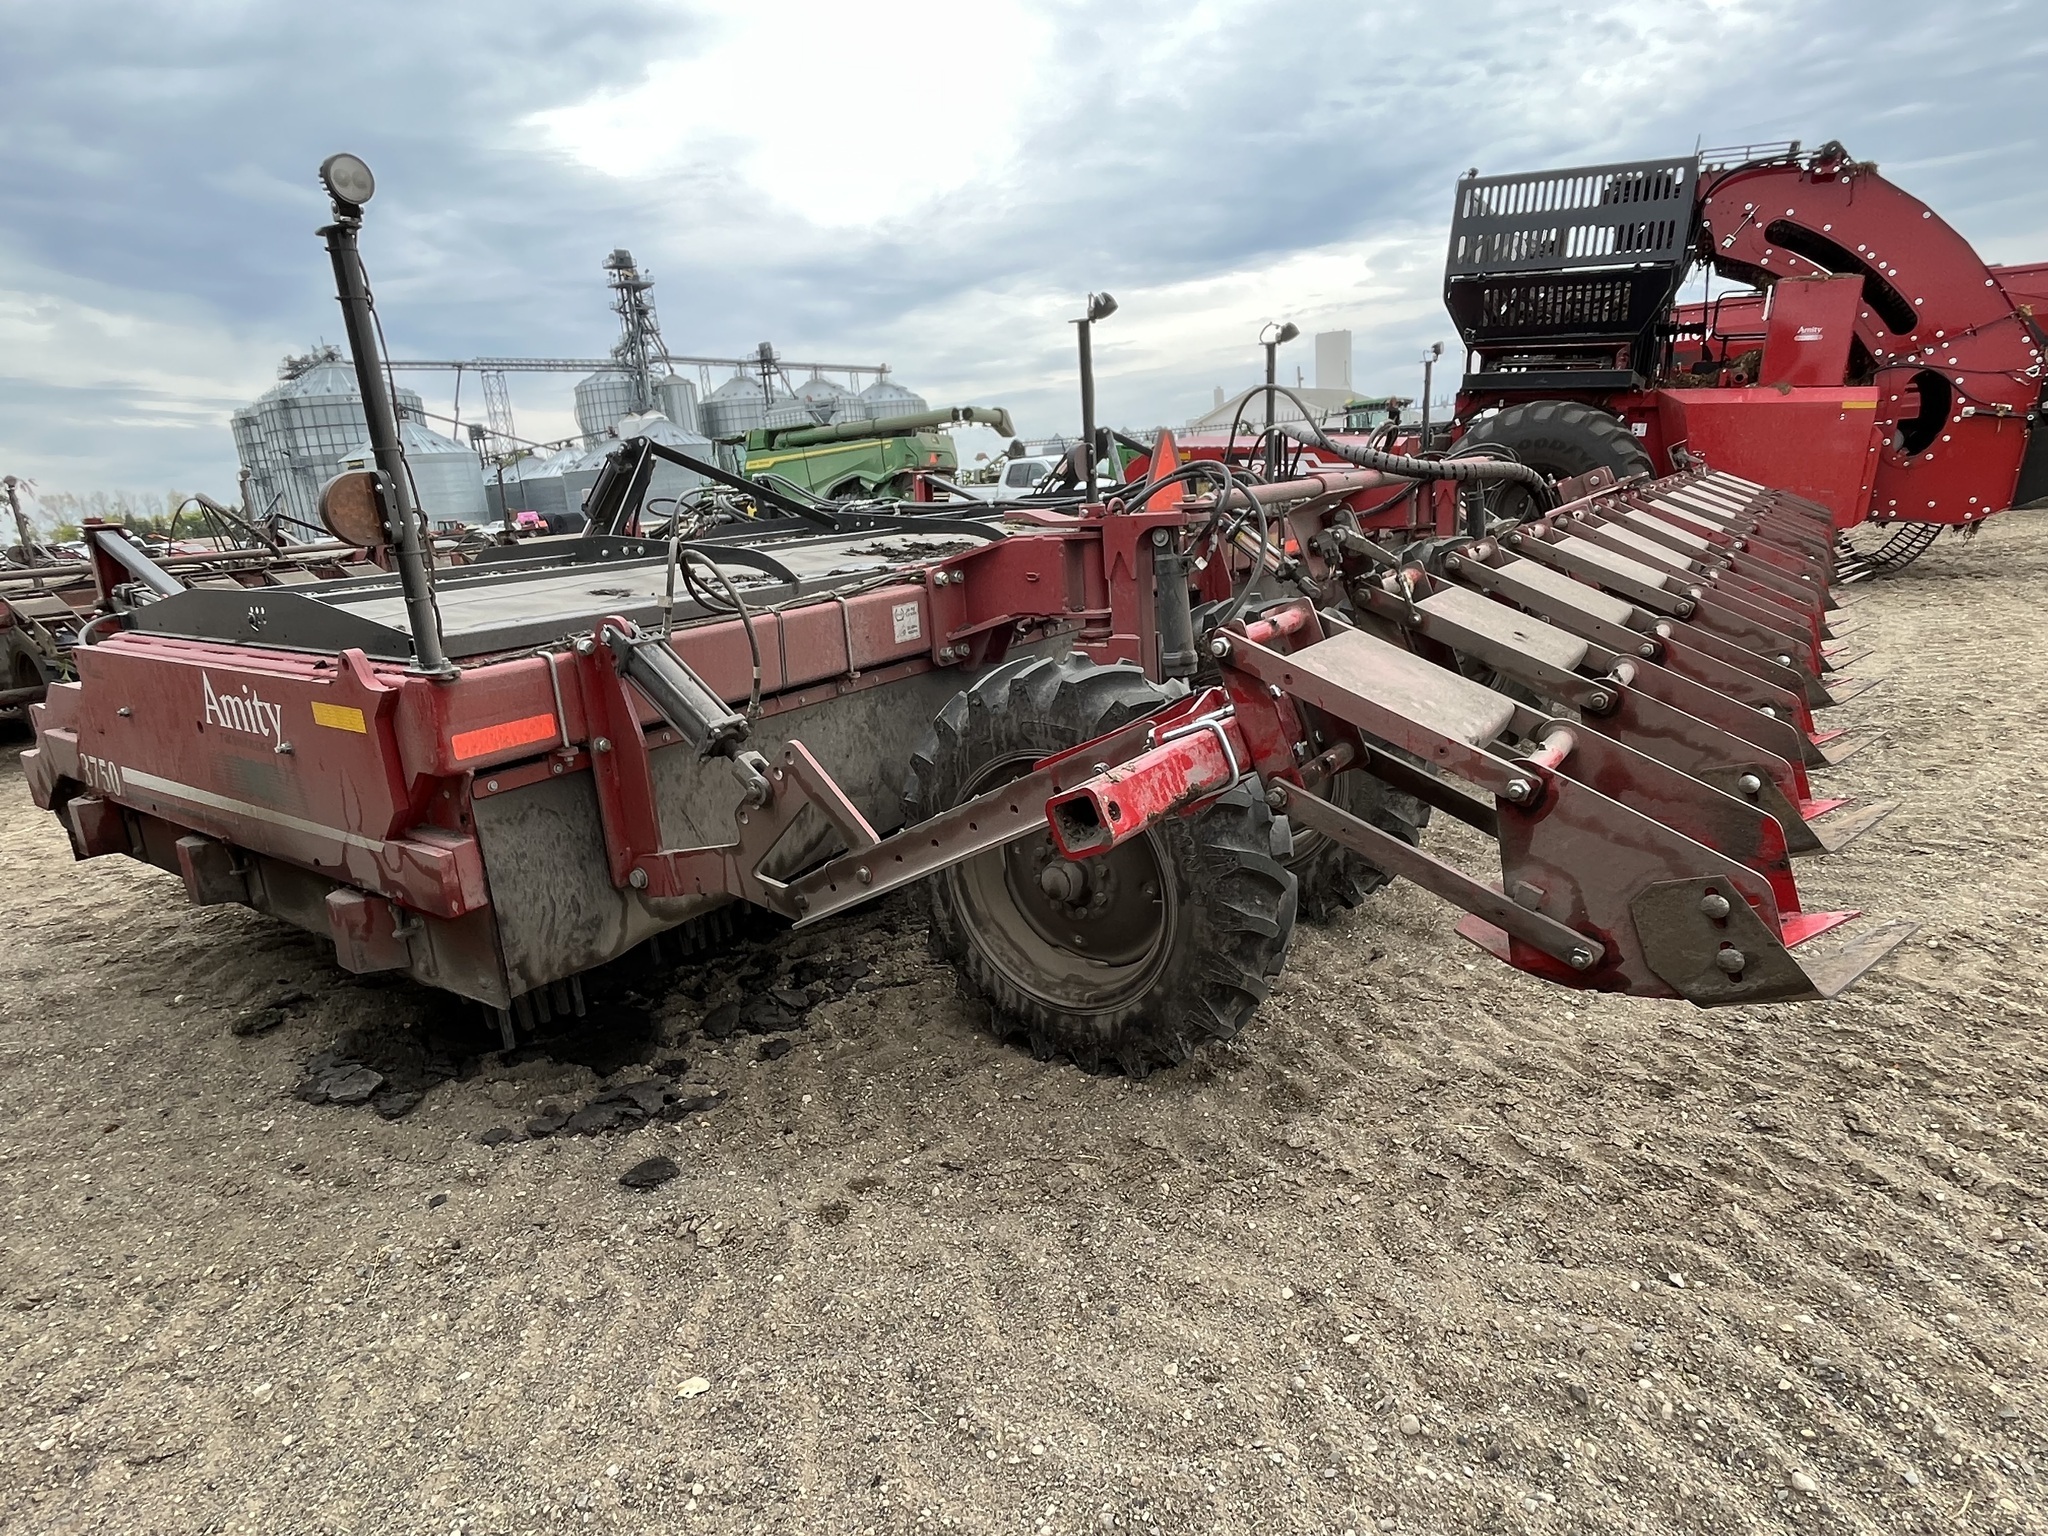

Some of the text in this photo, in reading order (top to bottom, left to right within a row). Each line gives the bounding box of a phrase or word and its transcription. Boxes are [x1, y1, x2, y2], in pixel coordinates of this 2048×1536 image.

[1796, 325, 1824, 334] Amity
[201, 669, 281, 753] Amity
[79, 752, 122, 797] 3750
